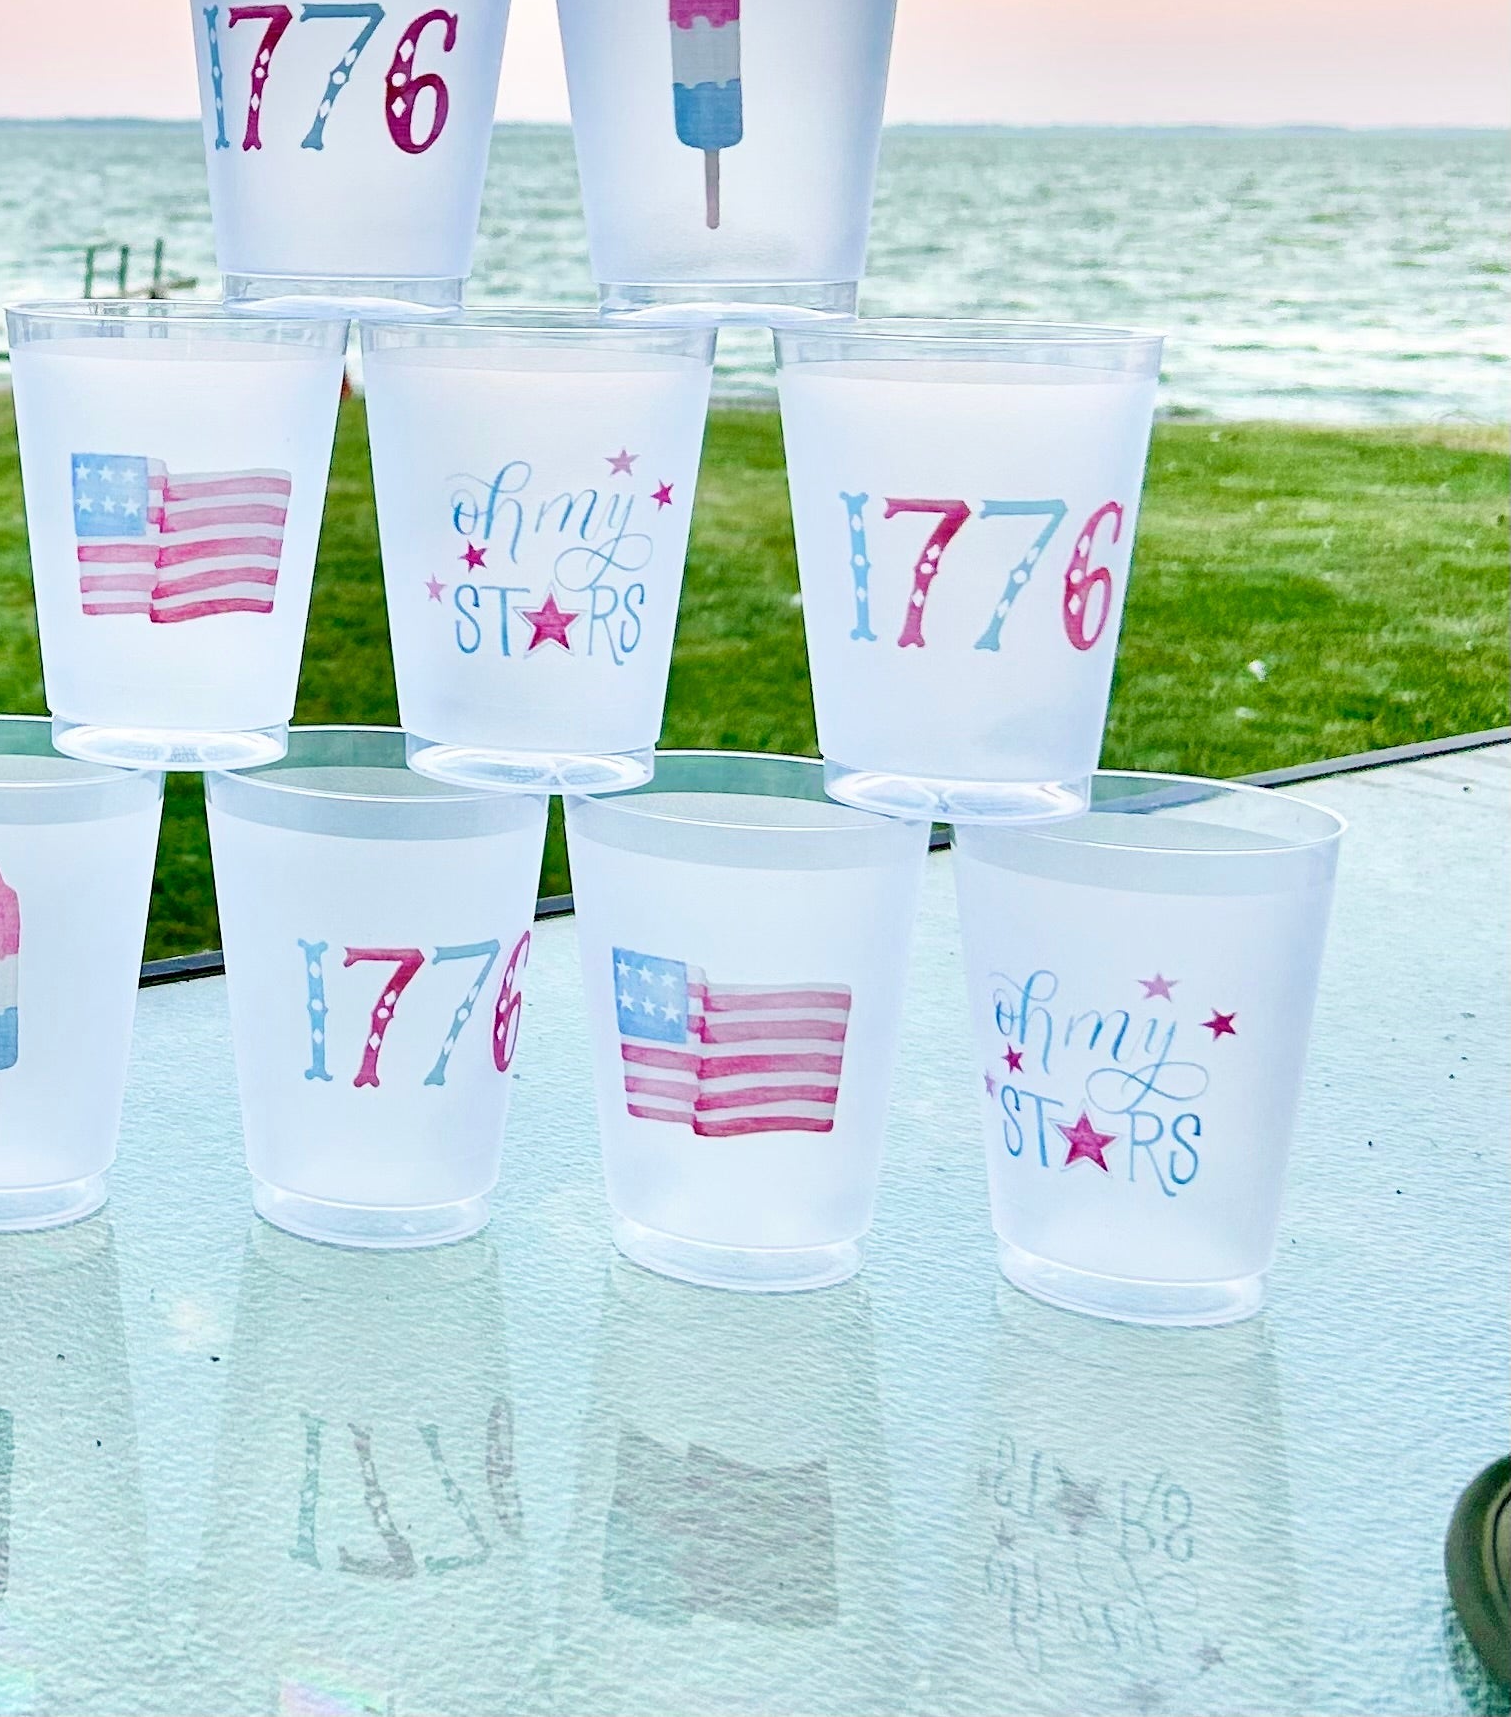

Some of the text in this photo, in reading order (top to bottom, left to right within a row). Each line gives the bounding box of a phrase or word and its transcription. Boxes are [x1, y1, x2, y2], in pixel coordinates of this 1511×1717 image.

[202, 2, 458, 155] 1776
[535, 488, 654, 592] my
[840, 492, 1123, 651] 1776
[297, 930, 531, 1088] 1776
